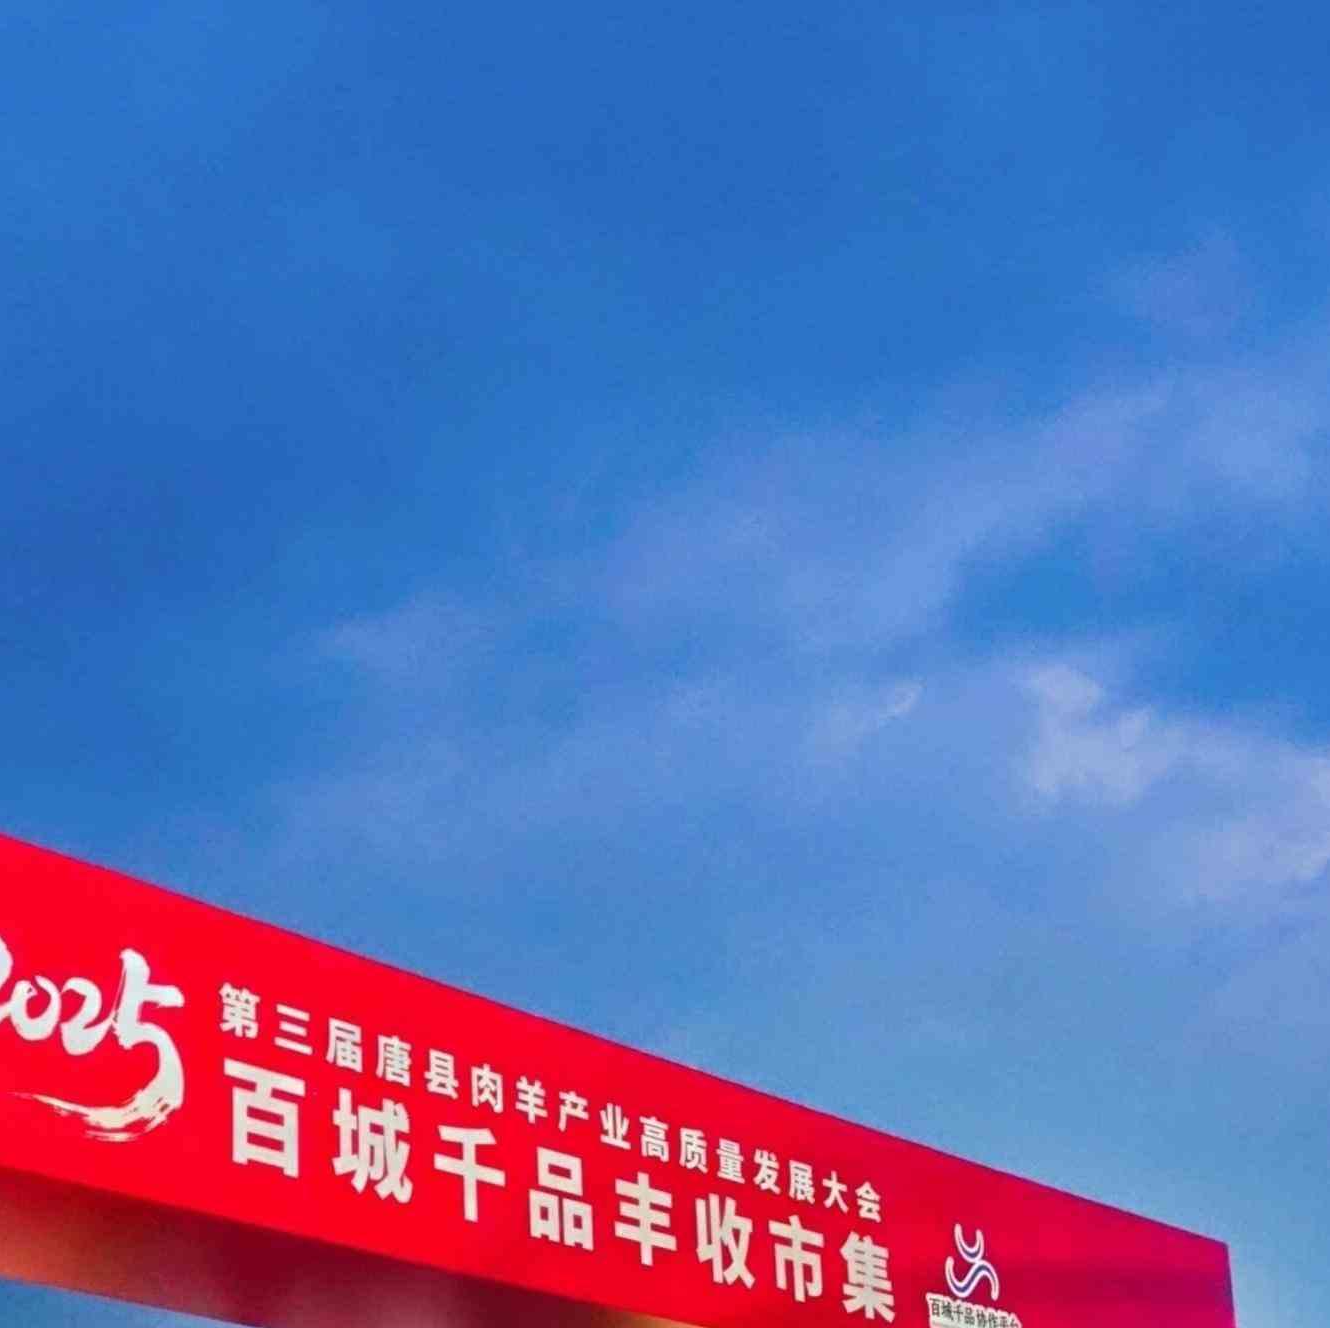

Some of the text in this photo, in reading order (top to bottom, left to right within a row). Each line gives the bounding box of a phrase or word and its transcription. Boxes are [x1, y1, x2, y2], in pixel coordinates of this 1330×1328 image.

[219, 981, 883, 1224] 第三届唐县肉羊产业高质量发展大会
[224, 1058, 896, 1323] 百城千品丰收市集
